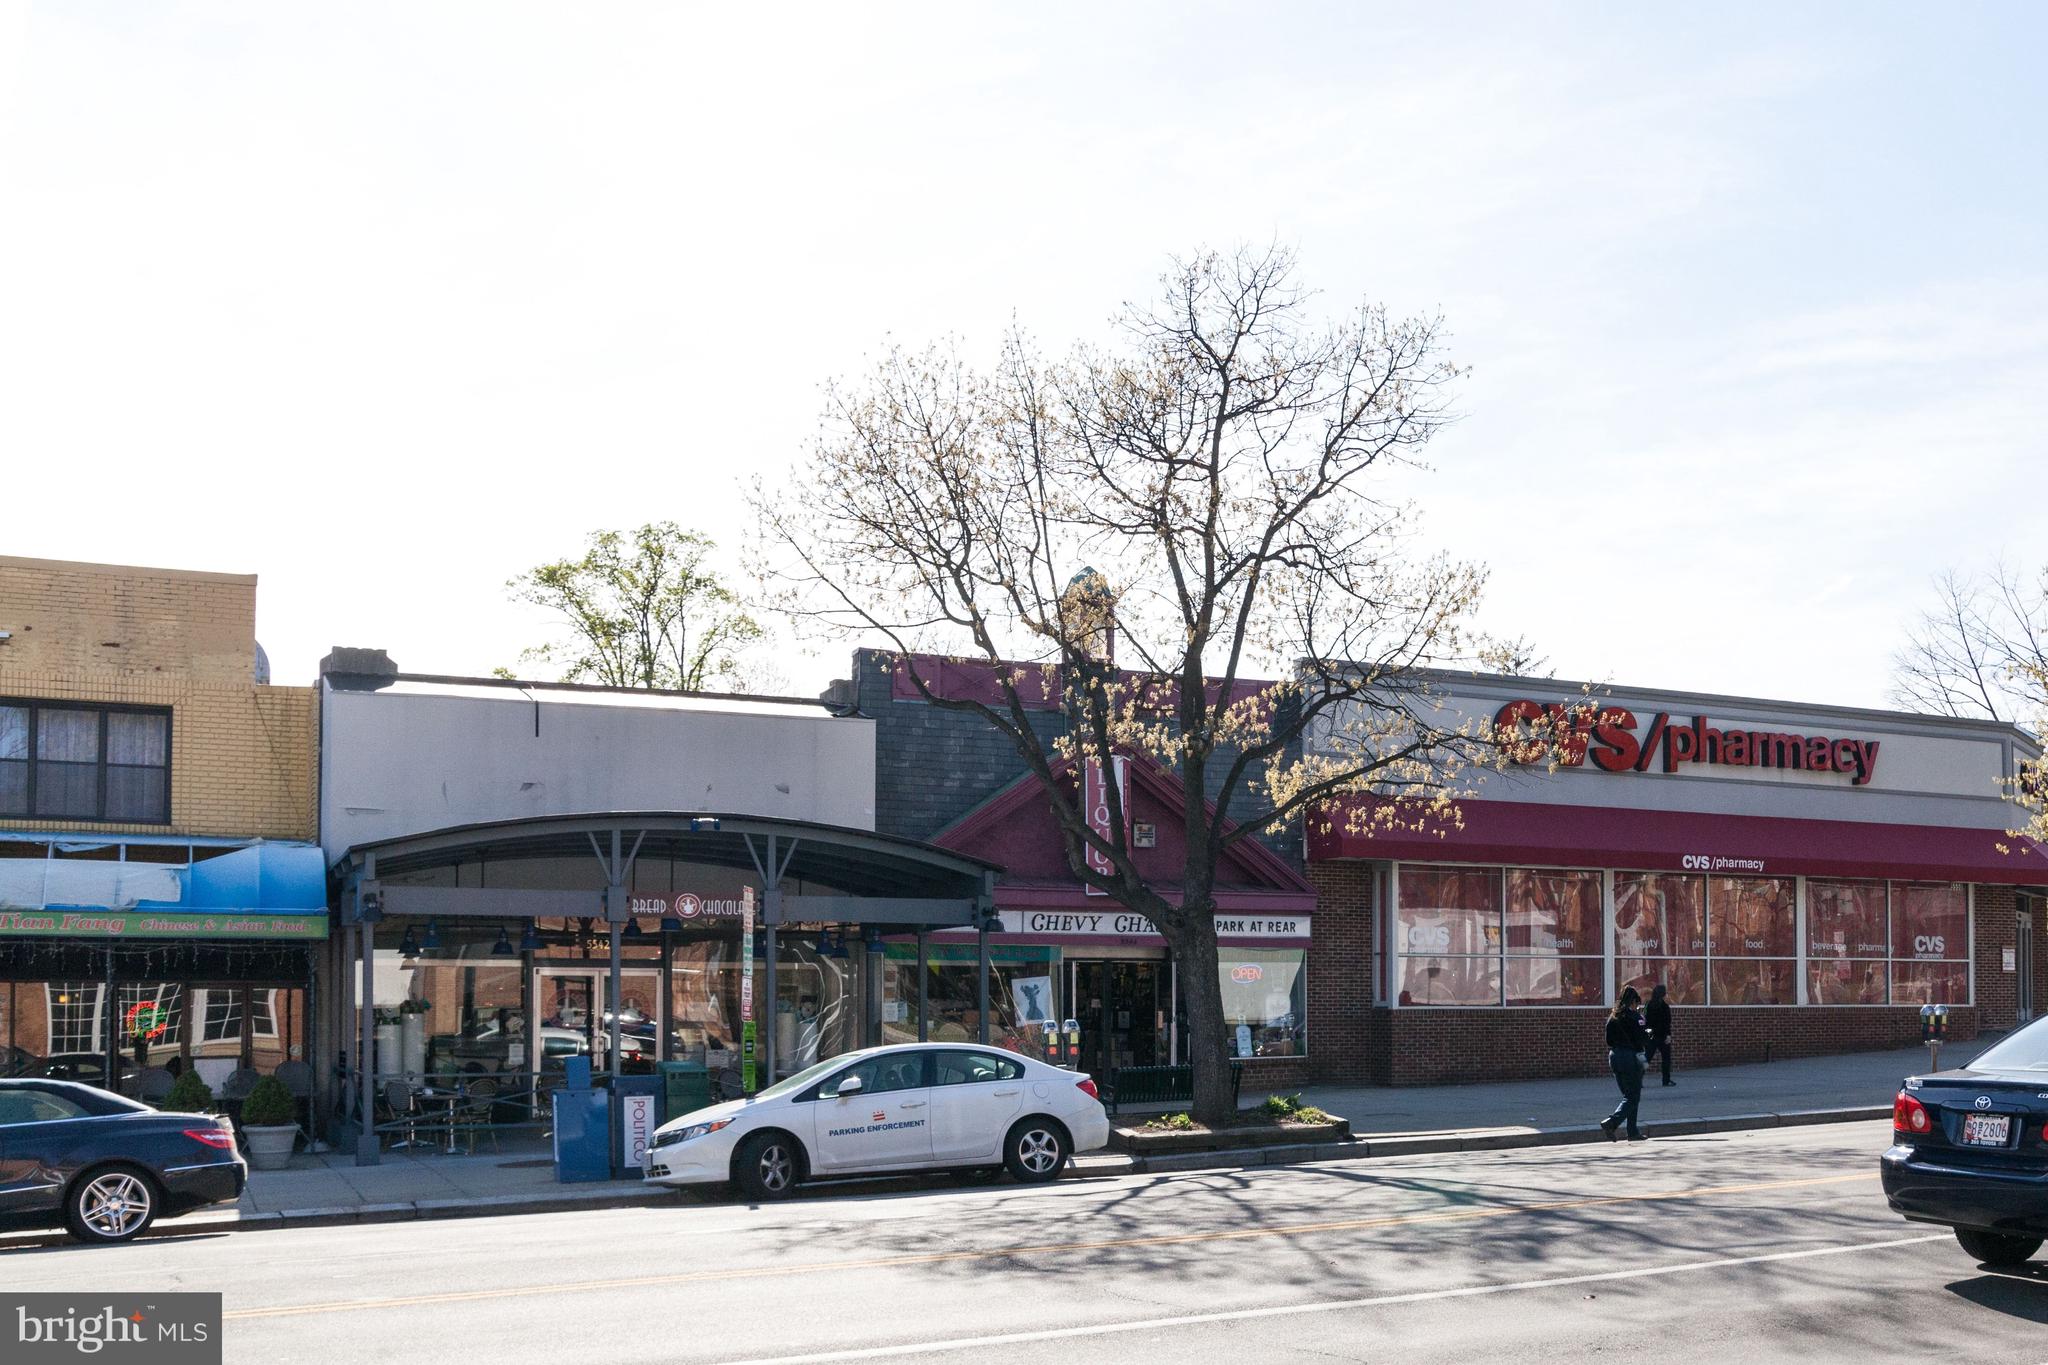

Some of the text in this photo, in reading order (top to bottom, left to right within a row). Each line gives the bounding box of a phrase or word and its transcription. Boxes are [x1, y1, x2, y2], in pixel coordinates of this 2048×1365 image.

[632, 899, 756, 916] BREAD CHOCOLA
[140, 918, 200, 930] Chinese
[204, 919, 217, 931] &
[221, 920, 266, 931] Asian
[271, 920, 306, 932] Food
[1031, 913, 1161, 933] CHEVY CHA
[1216, 920, 1296, 933] PARK AT REAR
[1409, 926, 1449, 945] CVS
[586, 939, 610, 950] 5542
[1691, 939, 1717, 950] pho
[1745, 939, 1764, 948] food
[1858, 942, 1895, 954] pharmay
[1914, 935, 1945, 952] CVS
[1231, 967, 1263, 980] OPEN
[633, 1100, 646, 1162] POLITICO
[829, 1119, 925, 1137] PARKING ENFORCEMENT
